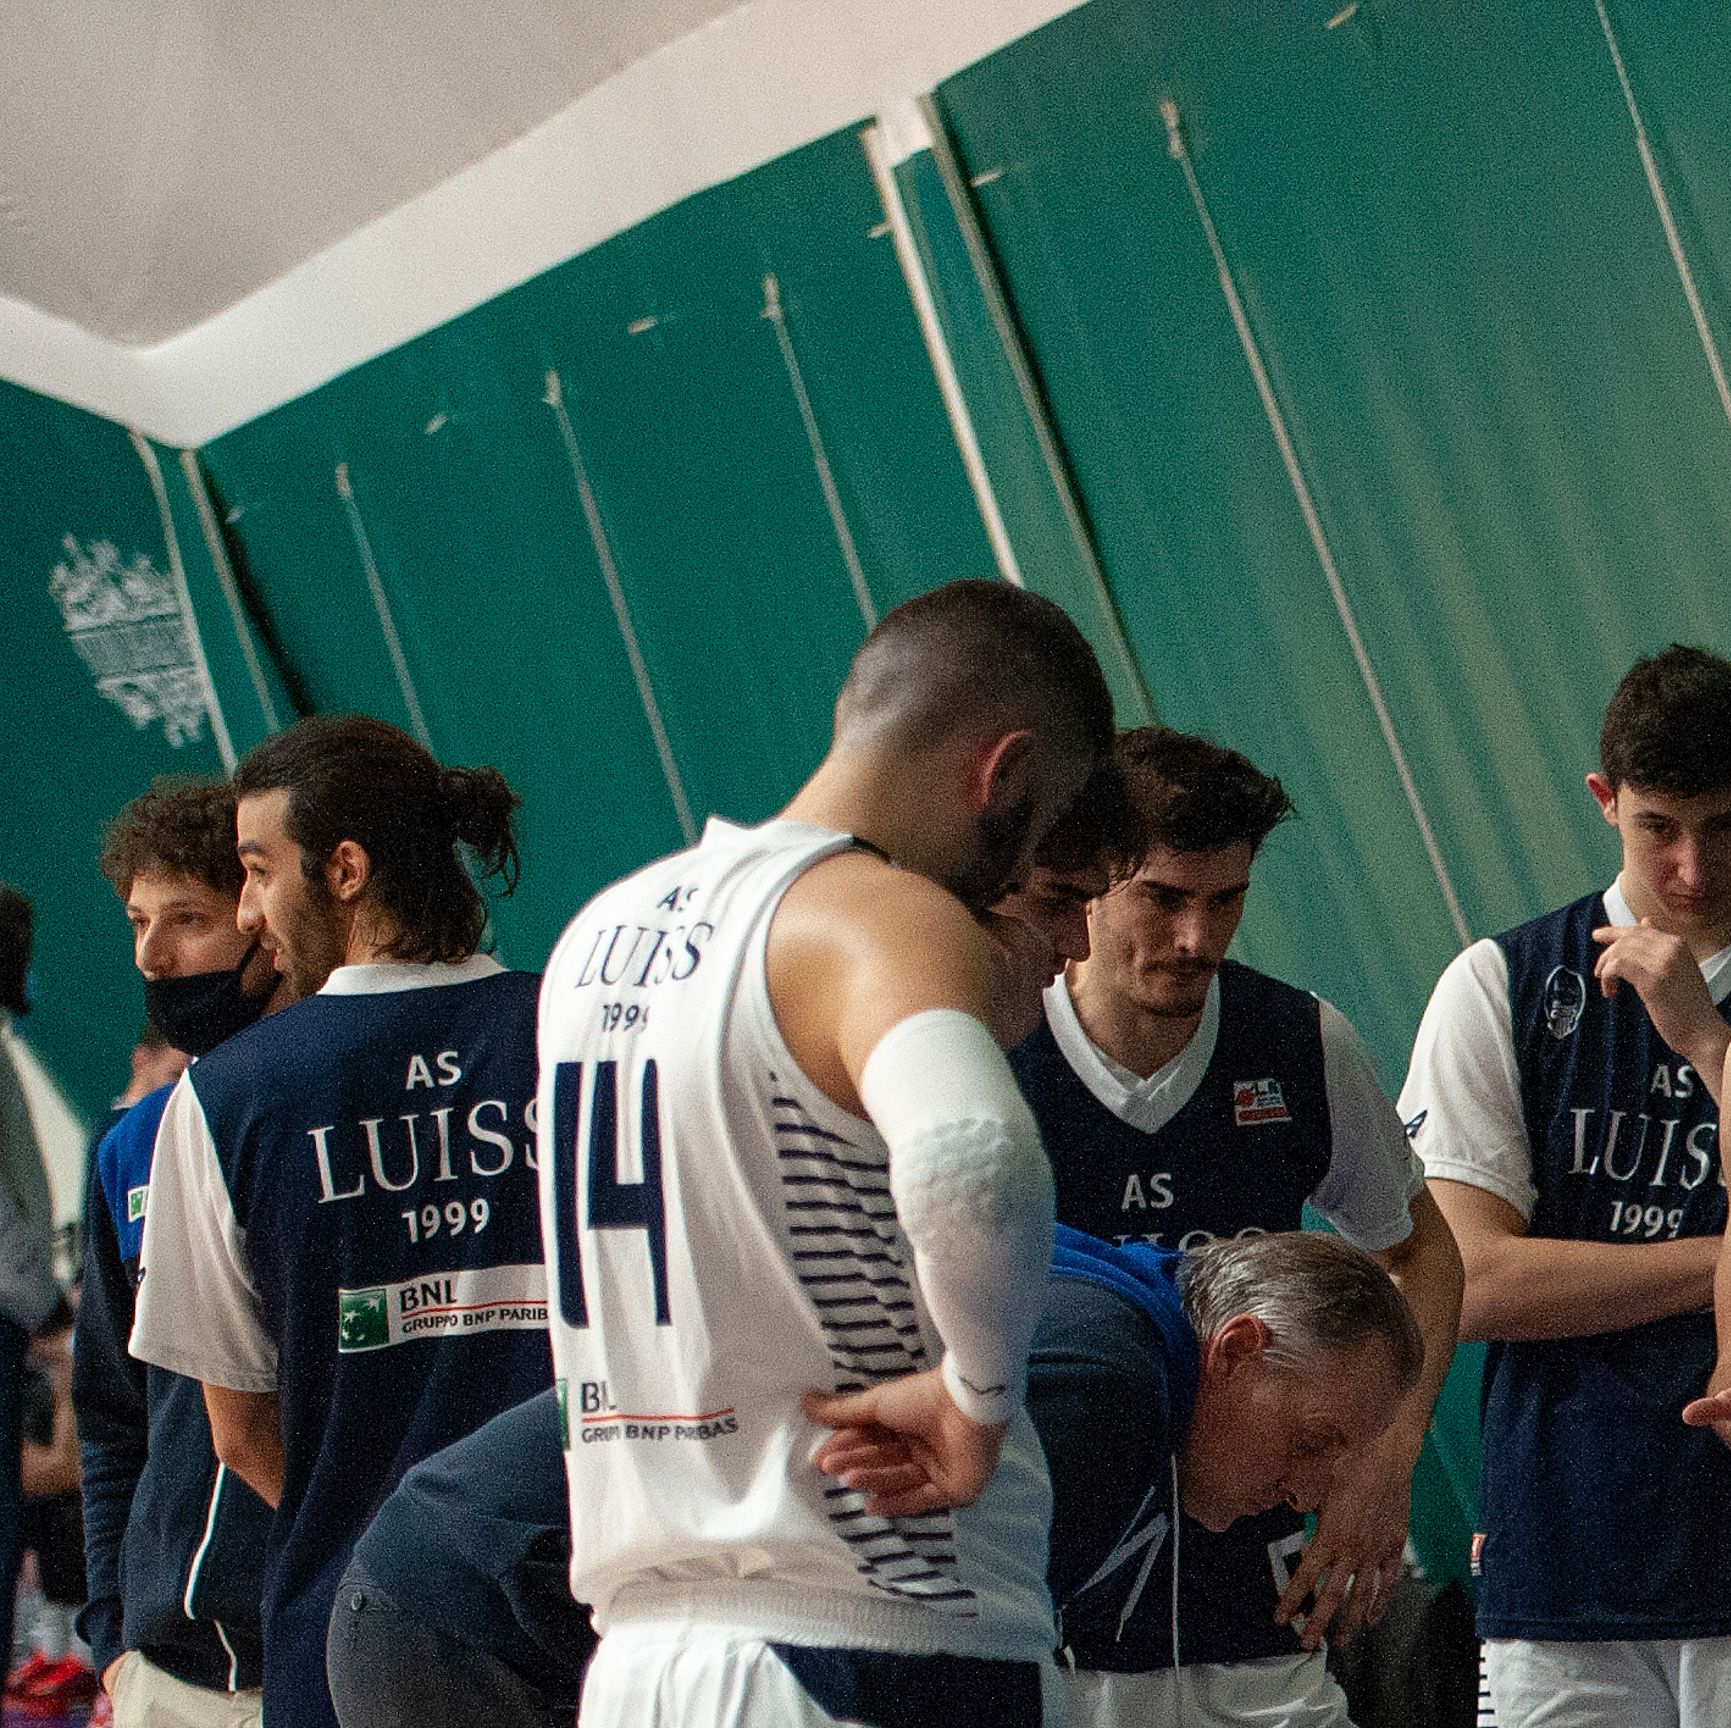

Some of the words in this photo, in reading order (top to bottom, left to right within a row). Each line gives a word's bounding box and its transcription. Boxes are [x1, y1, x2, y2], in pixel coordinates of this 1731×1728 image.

[405, 1050, 463, 1091] AS
[1651, 1063, 1695, 1099] AS
[1567, 1106, 1727, 1191] LUIS
[552, 1058, 674, 1330] 14
[1121, 1172, 1175, 1211] AS
[401, 1197, 491, 1244] 1999
[1610, 1201, 1684, 1240] 1999
[399, 1279, 458, 1313] BNL
[463, 1311, 496, 1327] BNP
[499, 1307, 549, 1321] PARIB
[581, 1382, 617, 1414] BL
[625, 1424, 670, 1441] BNP
